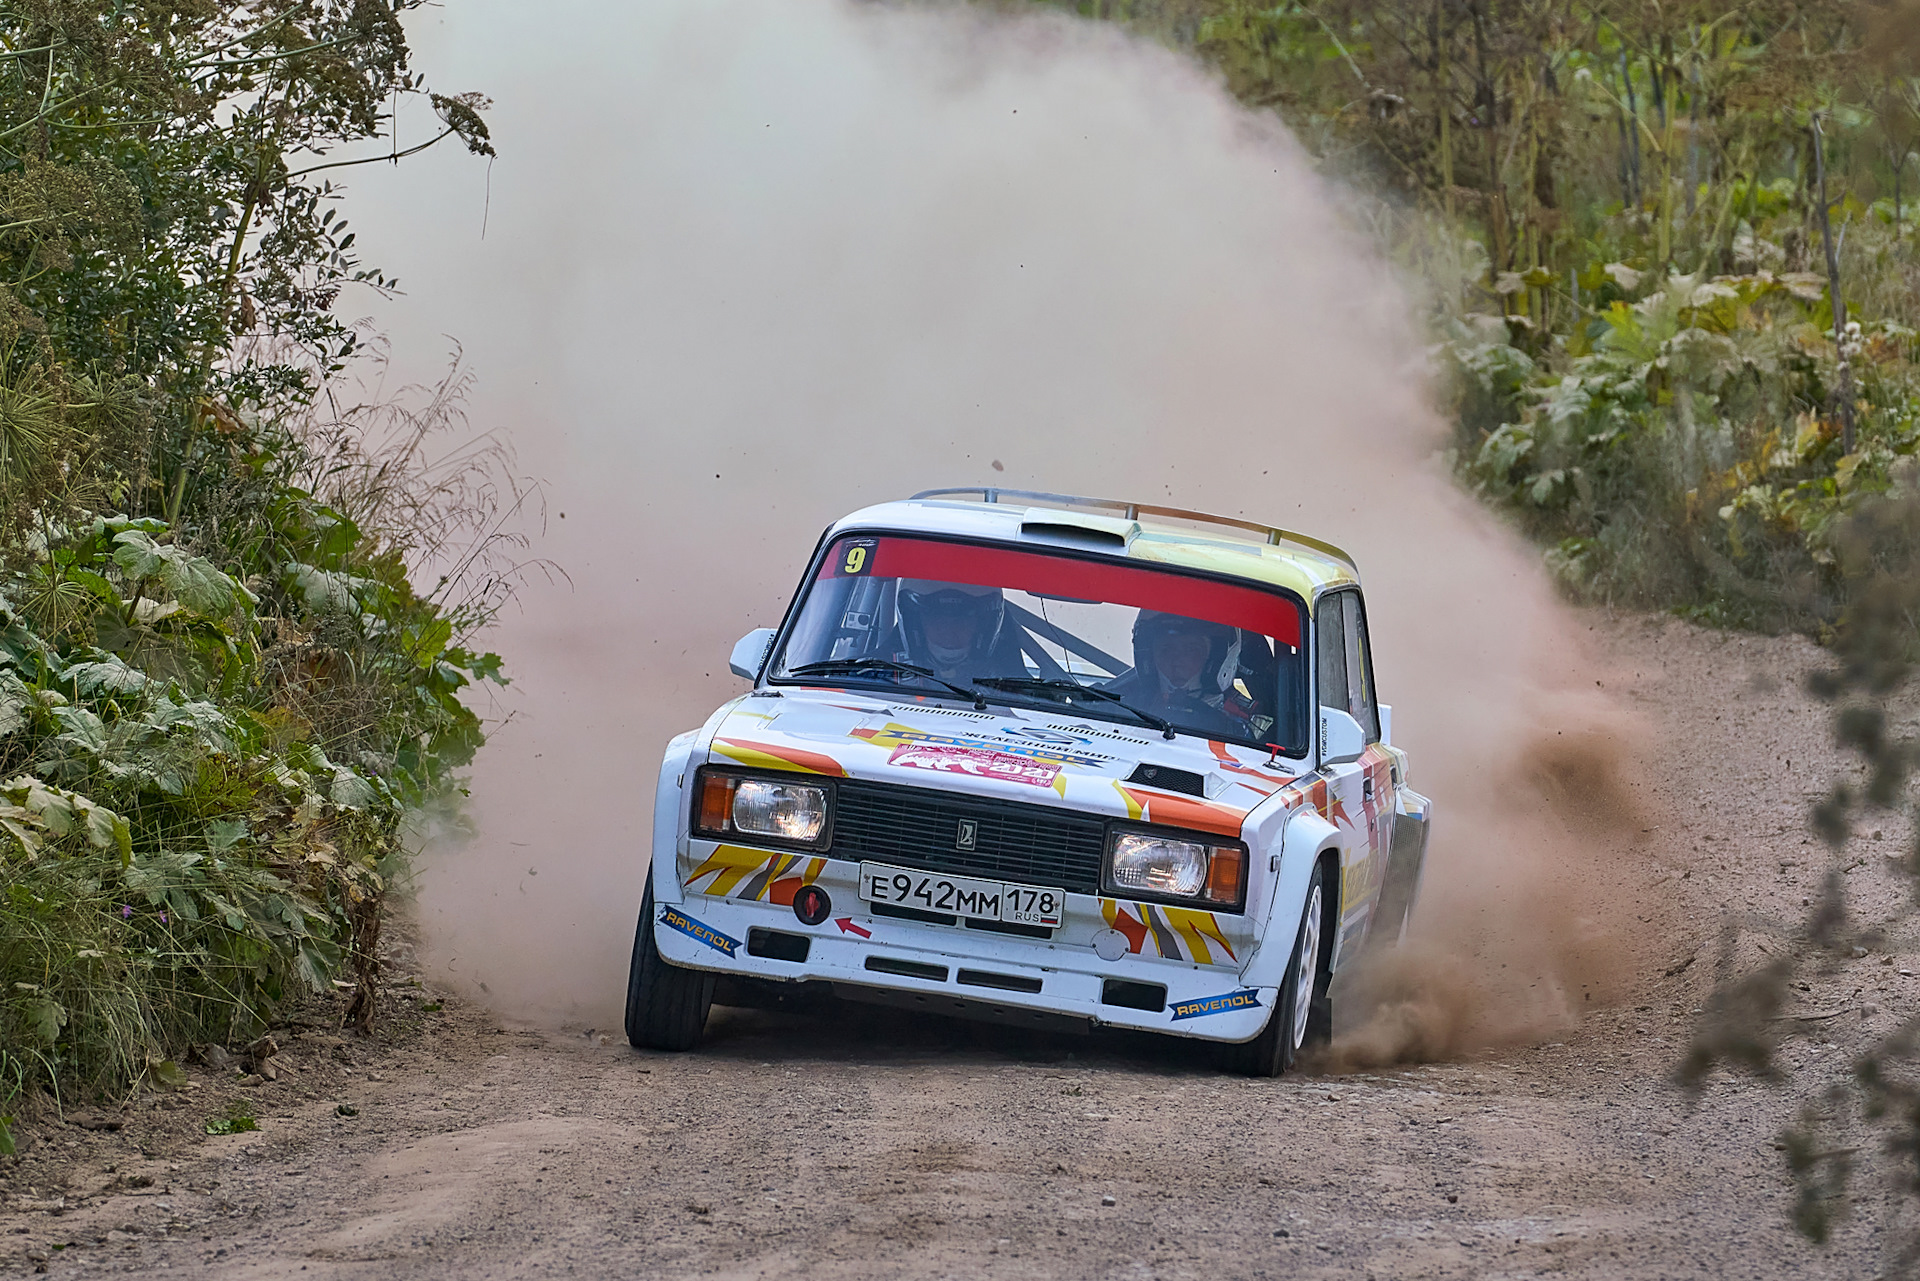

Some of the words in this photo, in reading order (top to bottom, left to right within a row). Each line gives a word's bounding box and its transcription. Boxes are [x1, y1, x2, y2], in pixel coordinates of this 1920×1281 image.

[845, 547, 867, 574] 9
[901, 733, 1086, 763] RAVENOL
[1007, 889, 1055, 913] 178
[1015, 911, 1040, 922] RUS
[666, 912, 732, 952] RAVENOL
[1177, 995, 1254, 1016] RAVENOL
